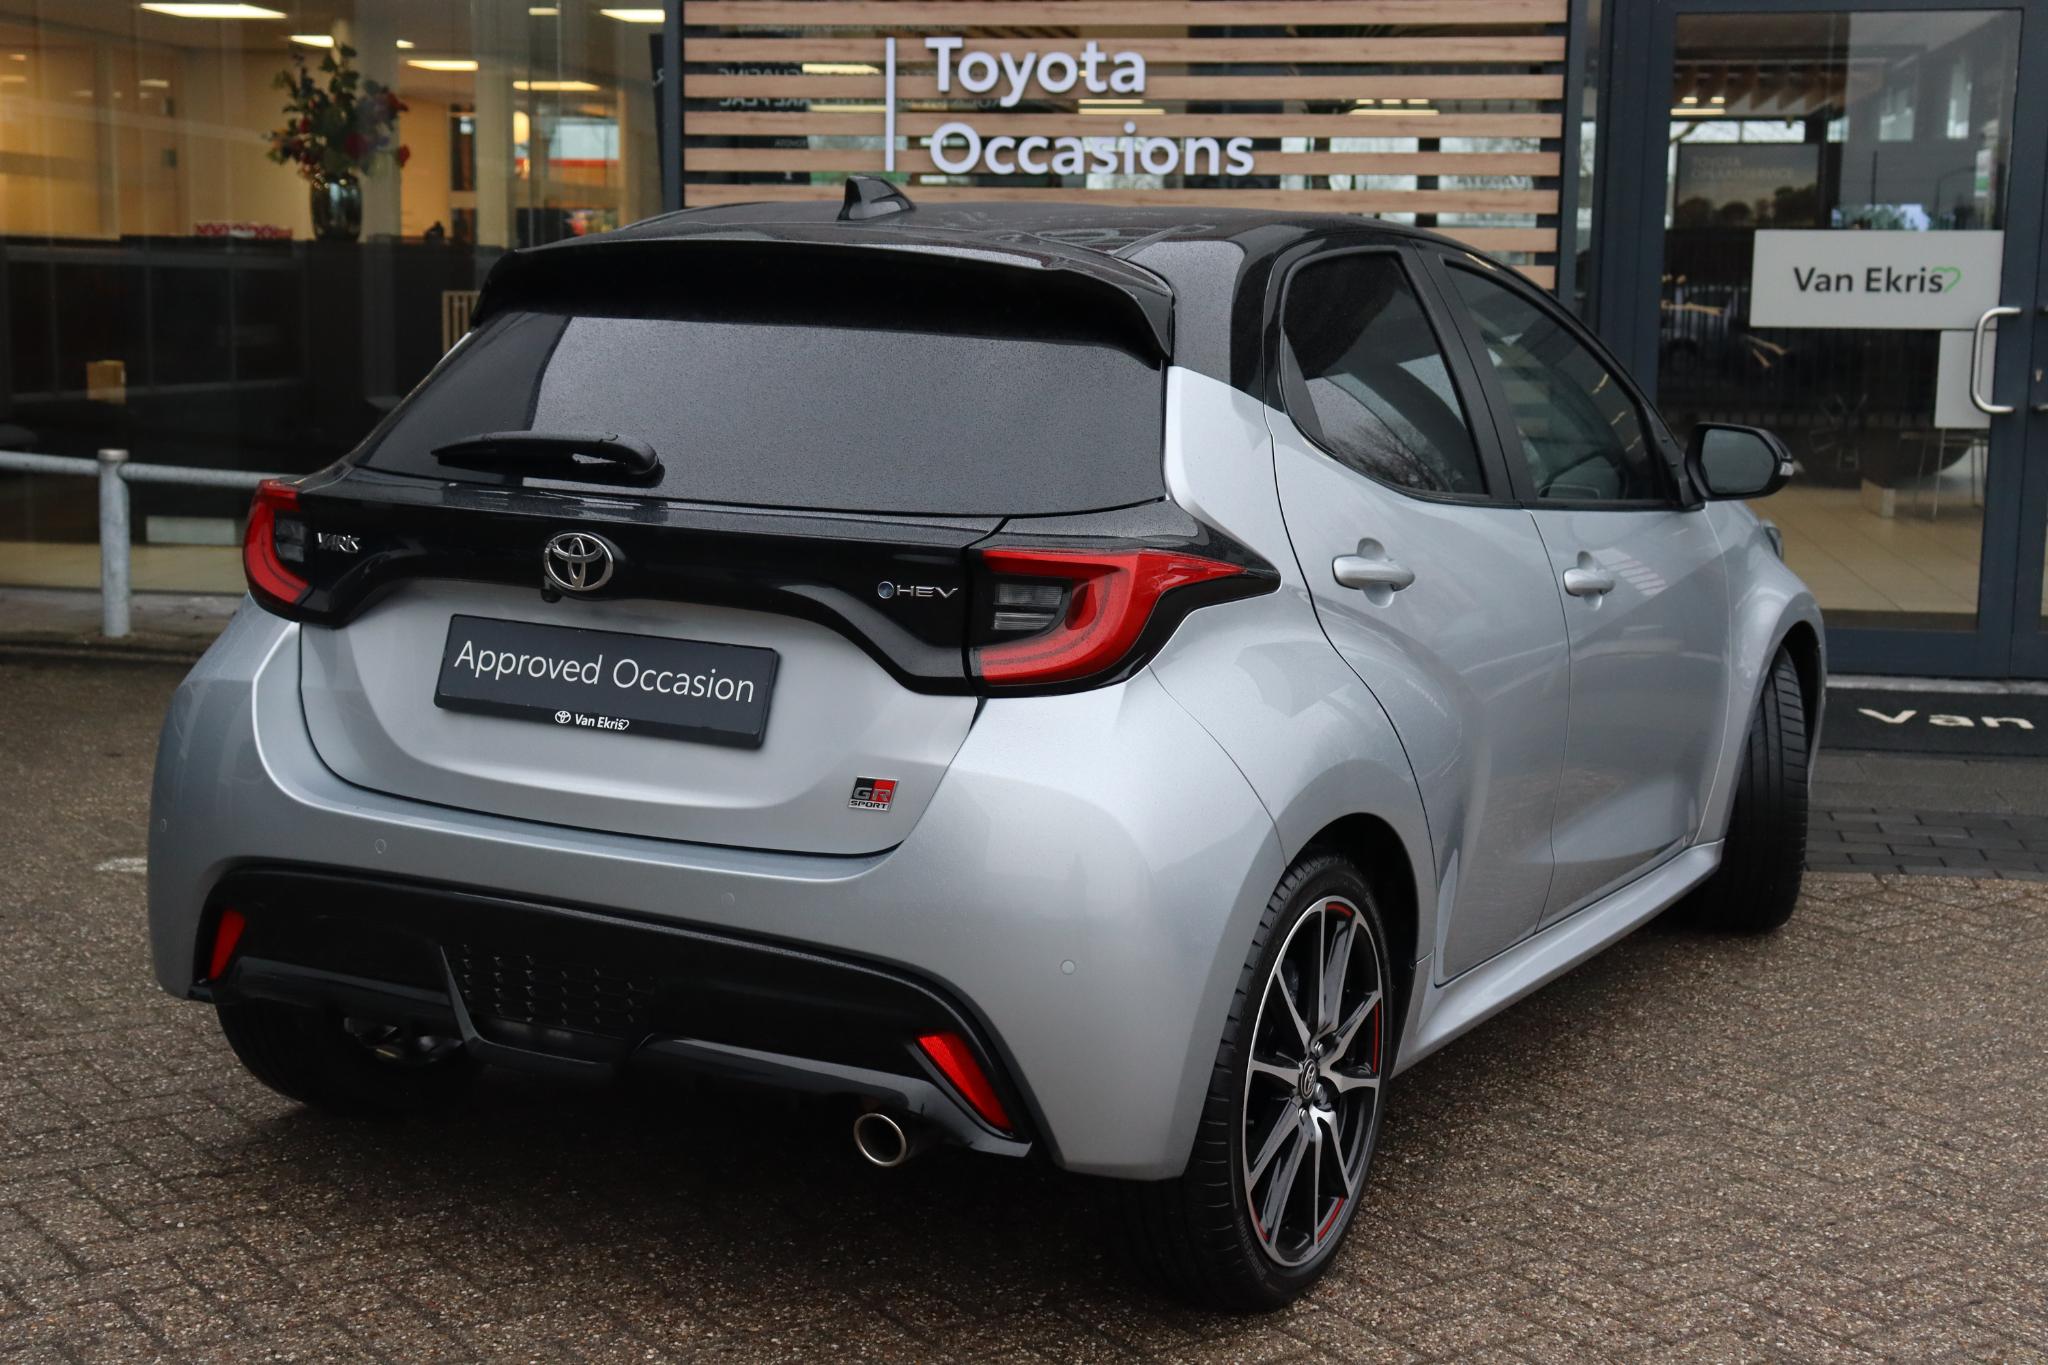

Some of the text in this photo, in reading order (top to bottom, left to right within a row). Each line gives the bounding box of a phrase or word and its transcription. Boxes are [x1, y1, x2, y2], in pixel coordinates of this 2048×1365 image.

[925, 37, 1147, 107] Toyota
[929, 121, 1255, 175] Occasions
[1793, 266, 1944, 293] Van Ekris
[896, 584, 959, 599] HEV
[453, 640, 755, 703] Approved Occasion
[575, 713, 624, 730] Van Ekris
[1858, 708, 2035, 729] Van
[850, 800, 888, 809] SPORT
[853, 787, 891, 802] GR
